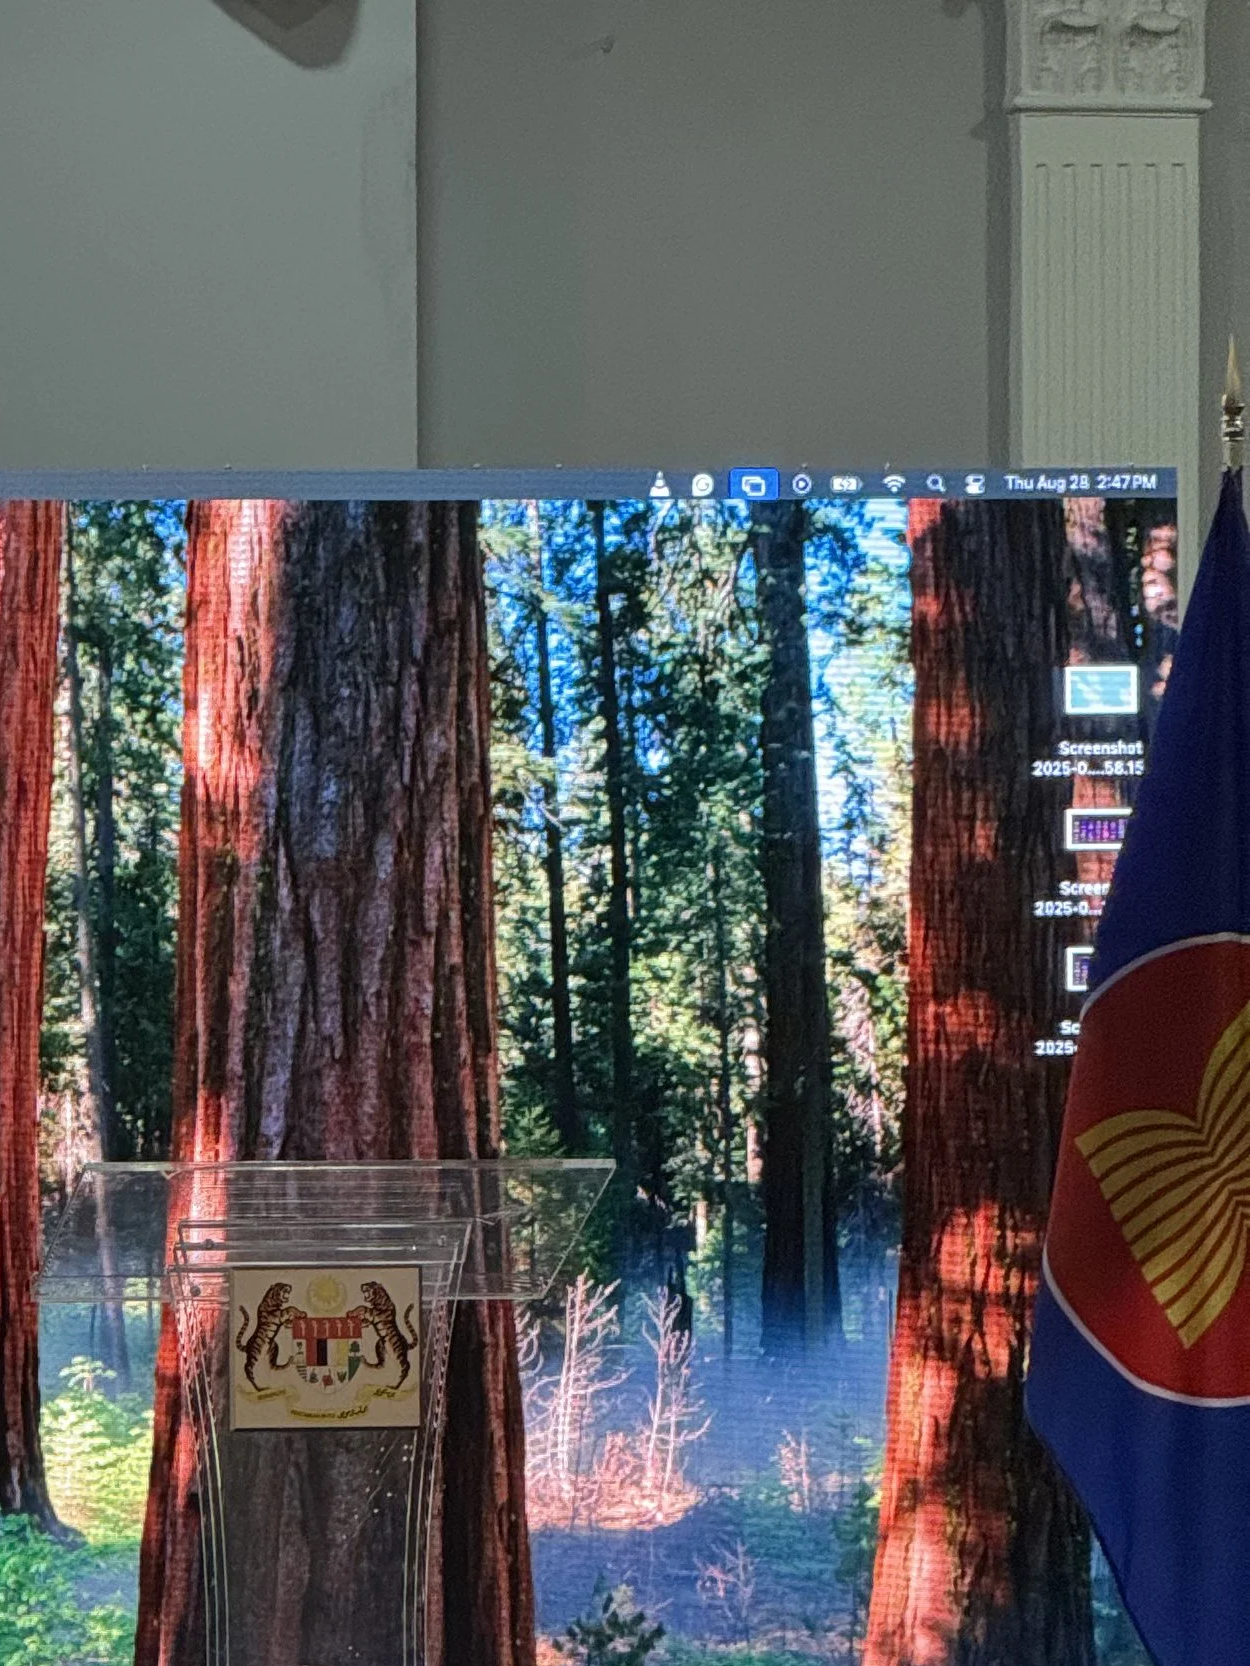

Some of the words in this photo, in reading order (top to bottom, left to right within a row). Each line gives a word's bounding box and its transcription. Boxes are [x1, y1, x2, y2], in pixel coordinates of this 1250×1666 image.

[1004, 474, 1034, 490] Thu
[1036, 474, 1066, 493] Aug
[1069, 474, 1090, 490] 28
[1058, 739, 1144, 755] Screenshot
[1061, 1020, 1081, 1035] Sc
[1034, 1040, 1078, 1055] 2025-
